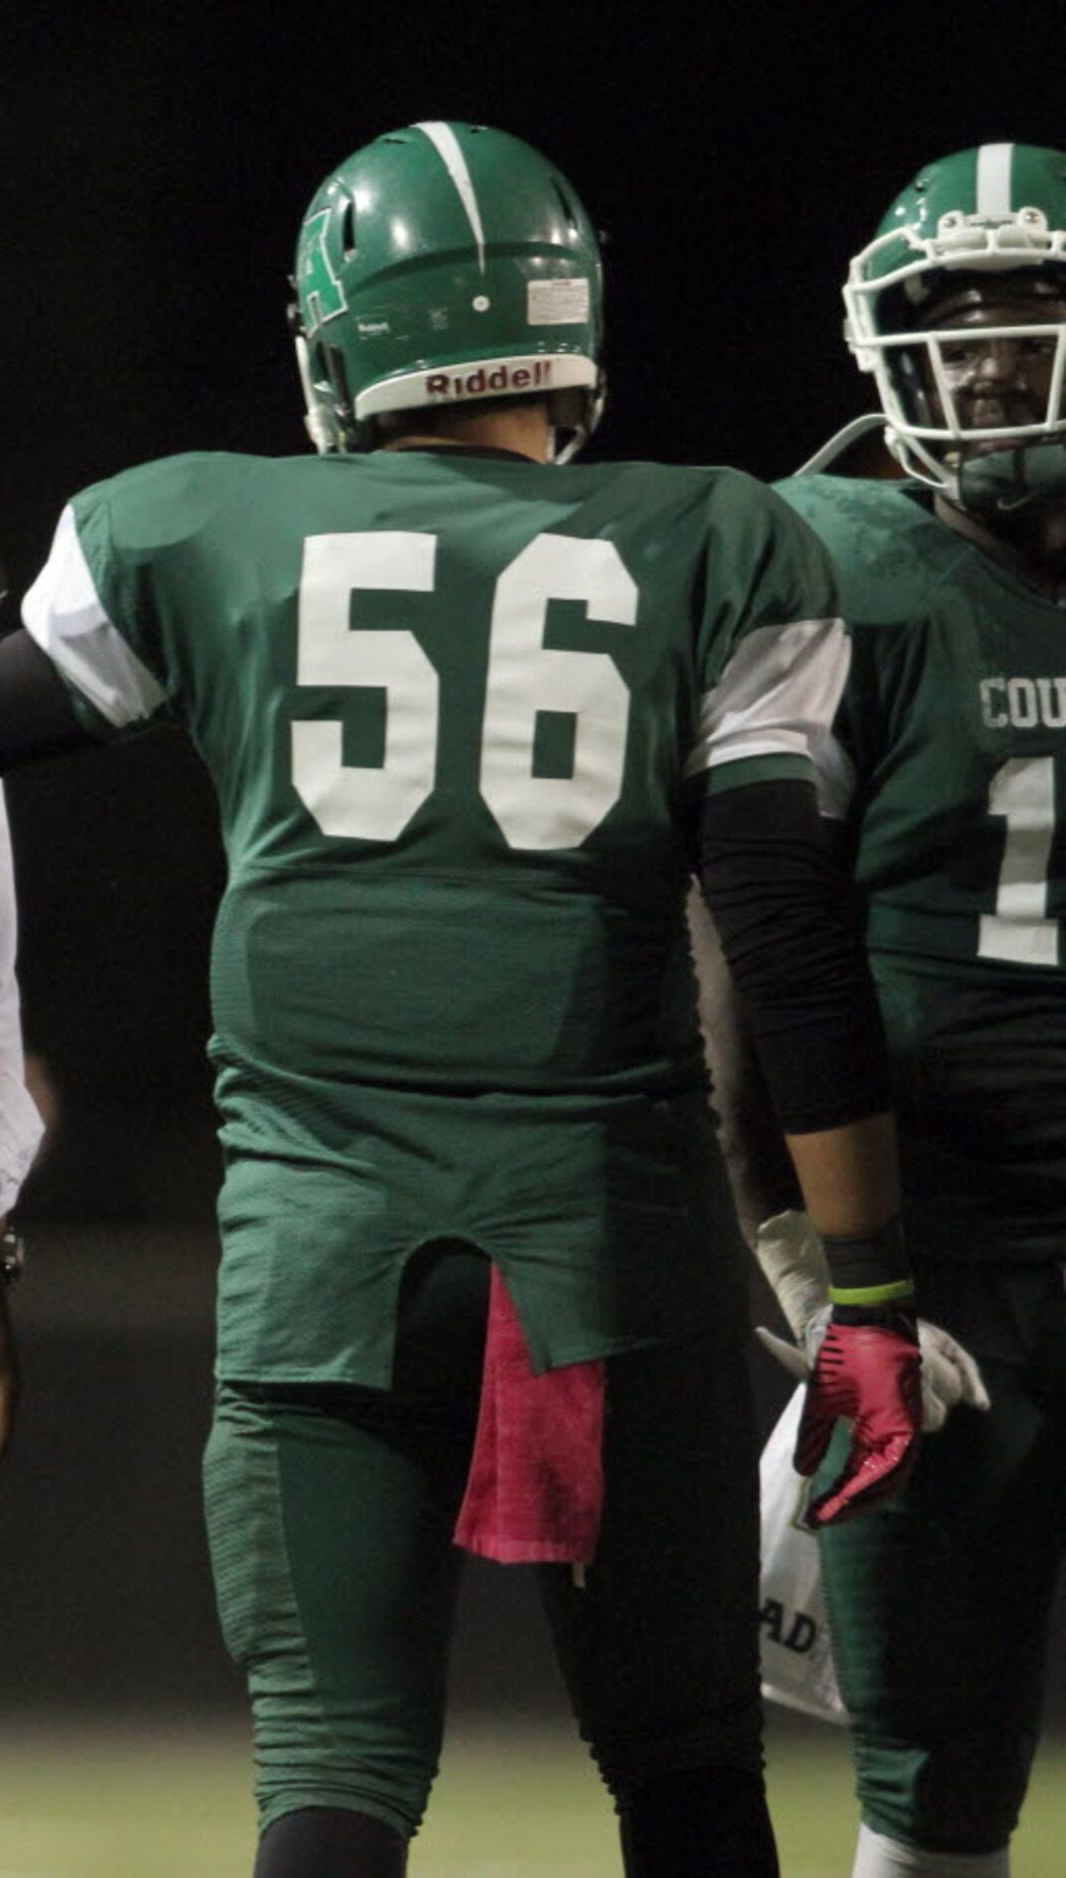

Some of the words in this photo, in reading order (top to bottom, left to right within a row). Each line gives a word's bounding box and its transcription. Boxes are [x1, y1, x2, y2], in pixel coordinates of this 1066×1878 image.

[426, 359, 551, 395] Riddell
[290, 530, 640, 851] 56
[979, 677, 1066, 728] COU
